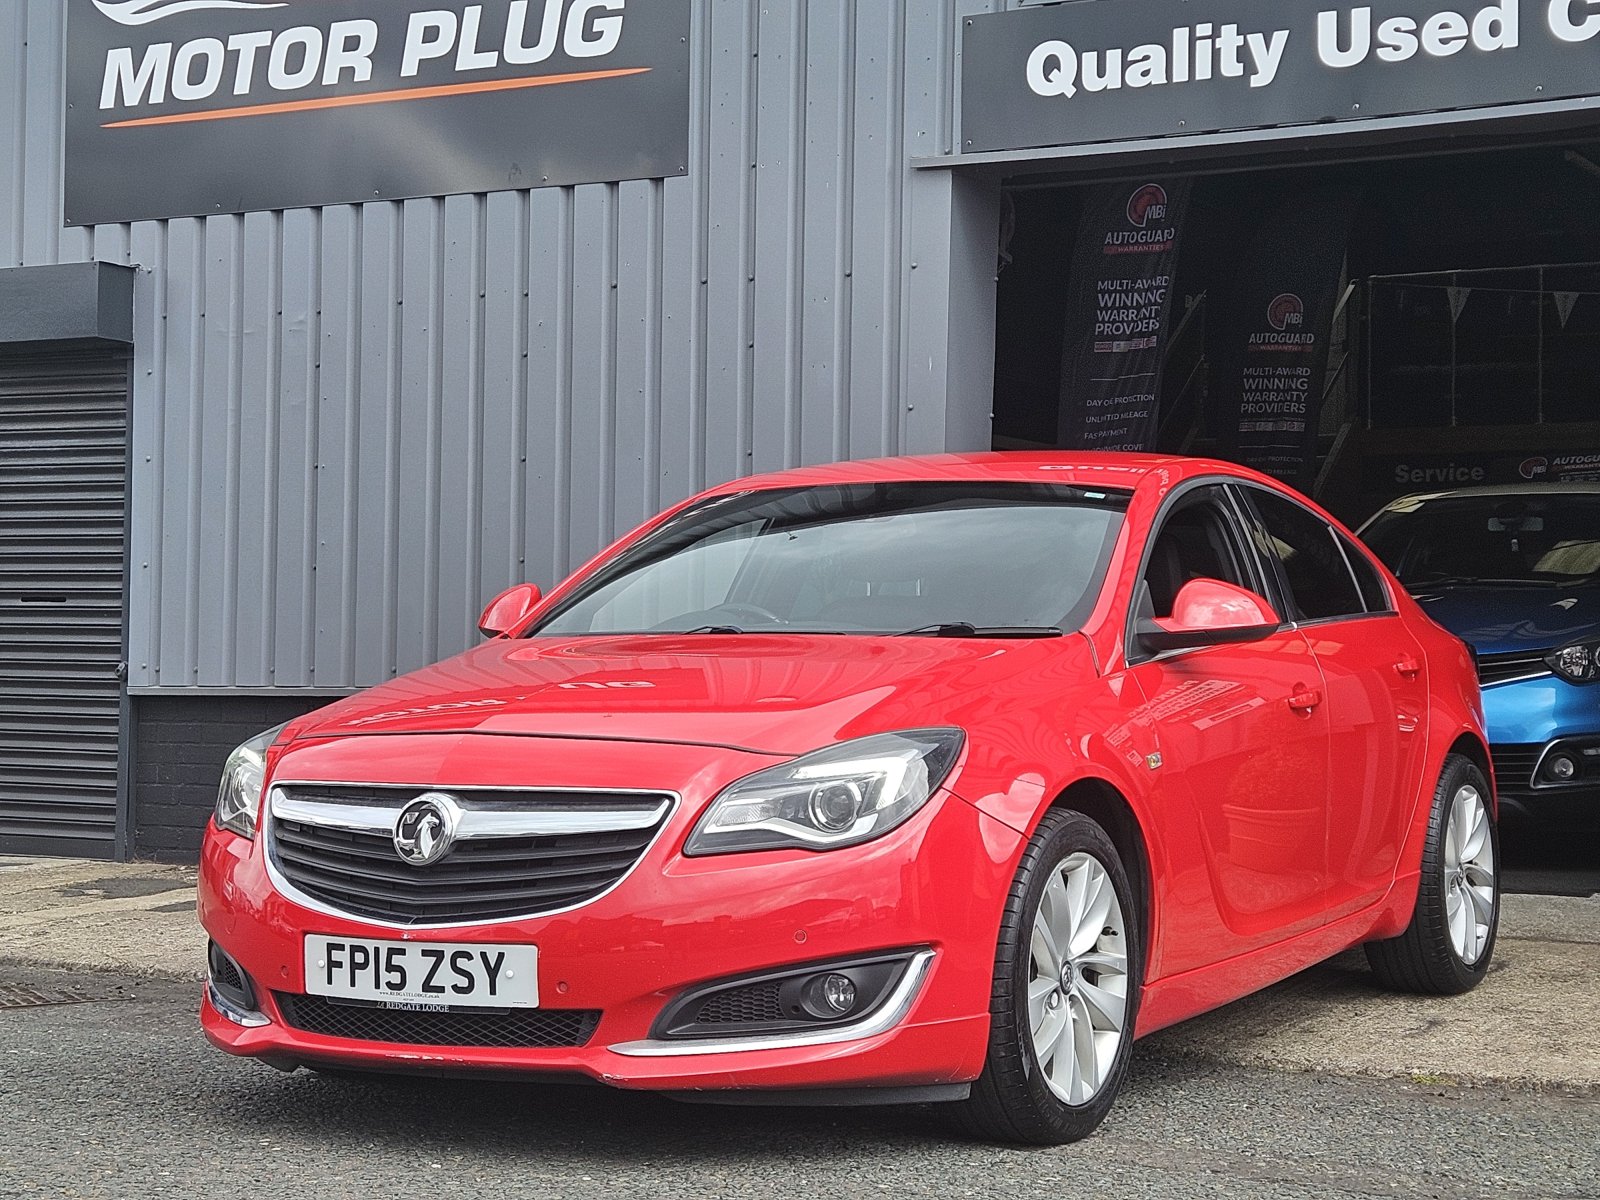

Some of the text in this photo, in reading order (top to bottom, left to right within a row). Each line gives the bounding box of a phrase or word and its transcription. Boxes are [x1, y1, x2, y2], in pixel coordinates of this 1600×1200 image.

[99, 0, 625, 109] MOTOR PLUG
[1026, 23, 1289, 99] Quality
[1317, 0, 1519, 68] Used
[1249, 332, 1315, 344] AUTOGUARD
[1243, 367, 1311, 376] MULTI-AWARD
[1243, 377, 1309, 390] WINNING
[1242, 391, 1309, 402] WARRANTY
[1240, 402, 1307, 414] PROVIDERS
[1395, 462, 1486, 483] Service
[326, 942, 506, 996] FP15 ZSY
[386, 1001, 420, 1011] REDGATE
[422, 1003, 450, 1013] LODGE
